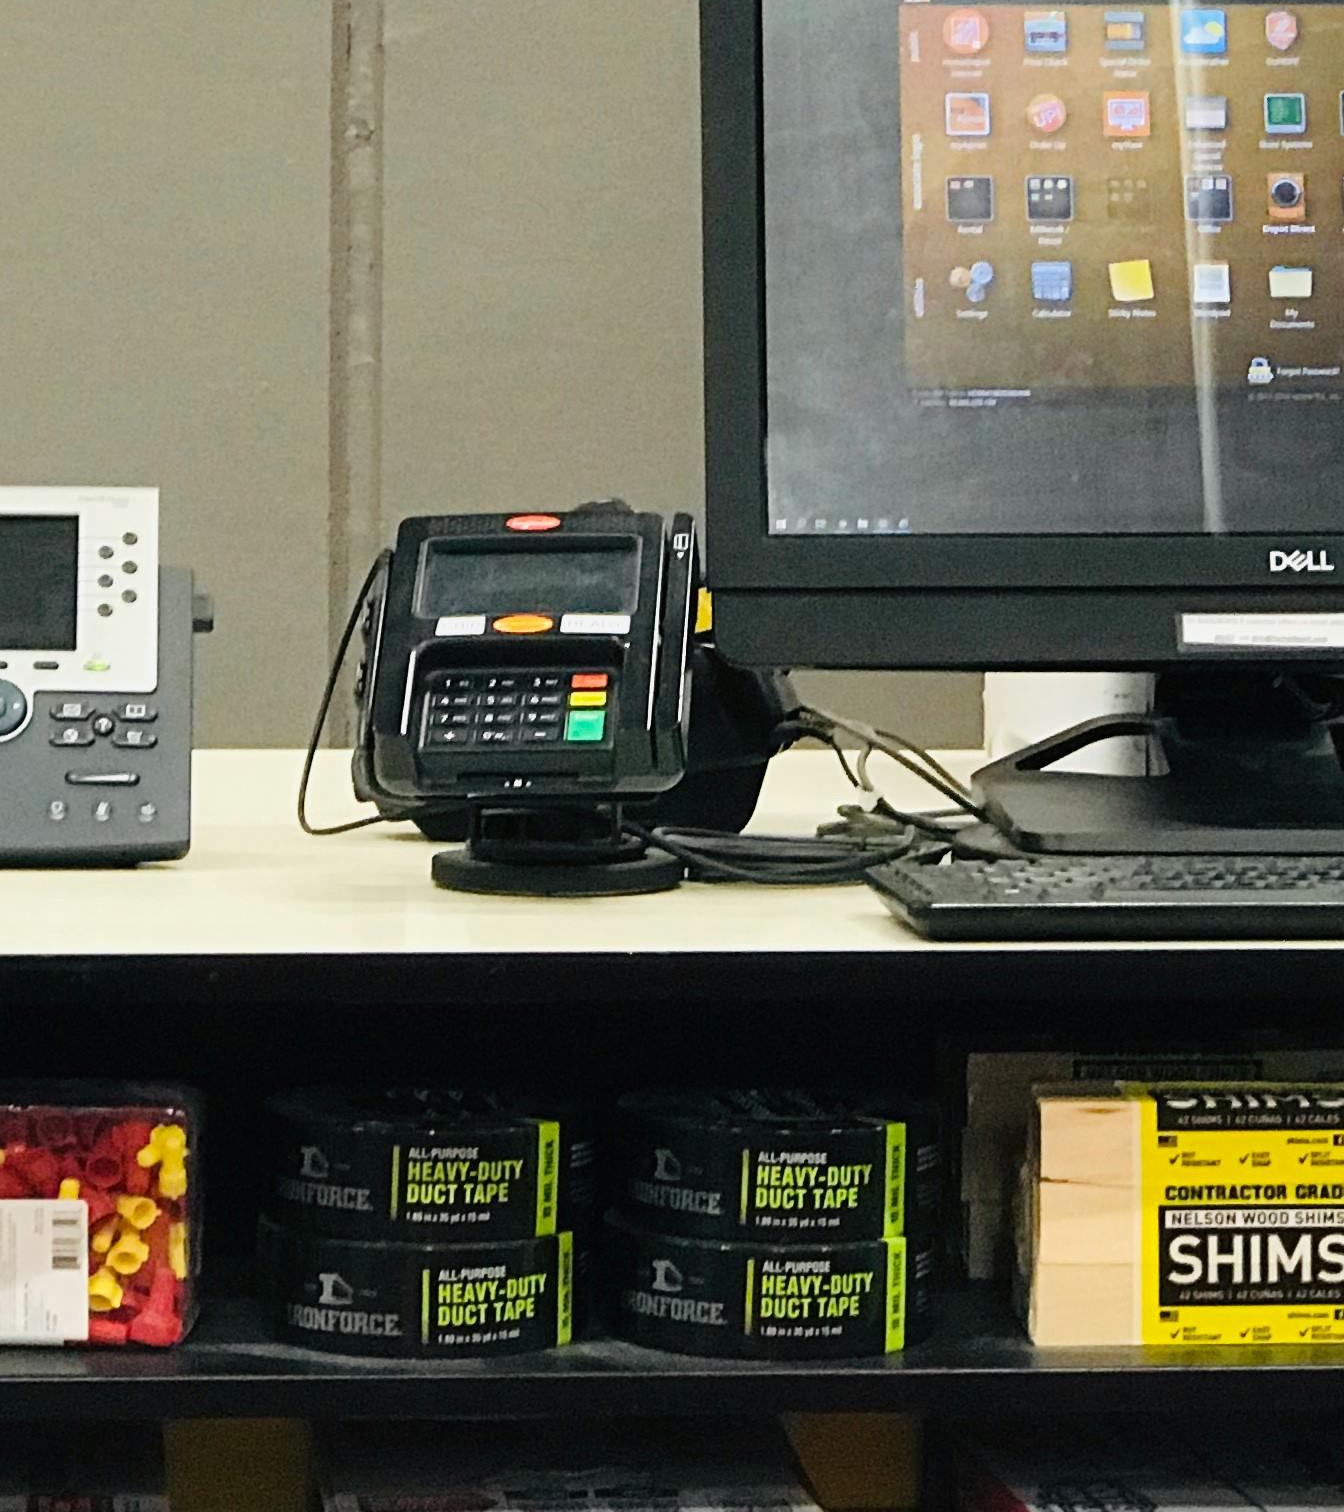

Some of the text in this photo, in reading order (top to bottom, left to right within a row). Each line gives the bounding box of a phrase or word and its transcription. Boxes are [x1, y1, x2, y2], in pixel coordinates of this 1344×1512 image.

[1269, 549, 1335, 572] DELL
[407, 1160, 523, 1183] HEAVY-DUTY
[756, 1164, 873, 1186] HEAVY-DUTY
[406, 1182, 509, 1205] DUCT TAPE
[755, 1187, 859, 1209] DUCT TAPE
[1165, 1184, 1287, 1201] CONTRACTOR
[1171, 1210, 1237, 1226] NELSON
[1242, 1210, 1290, 1225] WOOD
[437, 1273, 547, 1305] HEAVY-DUTY
[761, 1272, 874, 1297] HEAVY-DUTY
[437, 1297, 535, 1327] DUCT TAPE
[759, 1296, 860, 1319] DUCT TAPE
